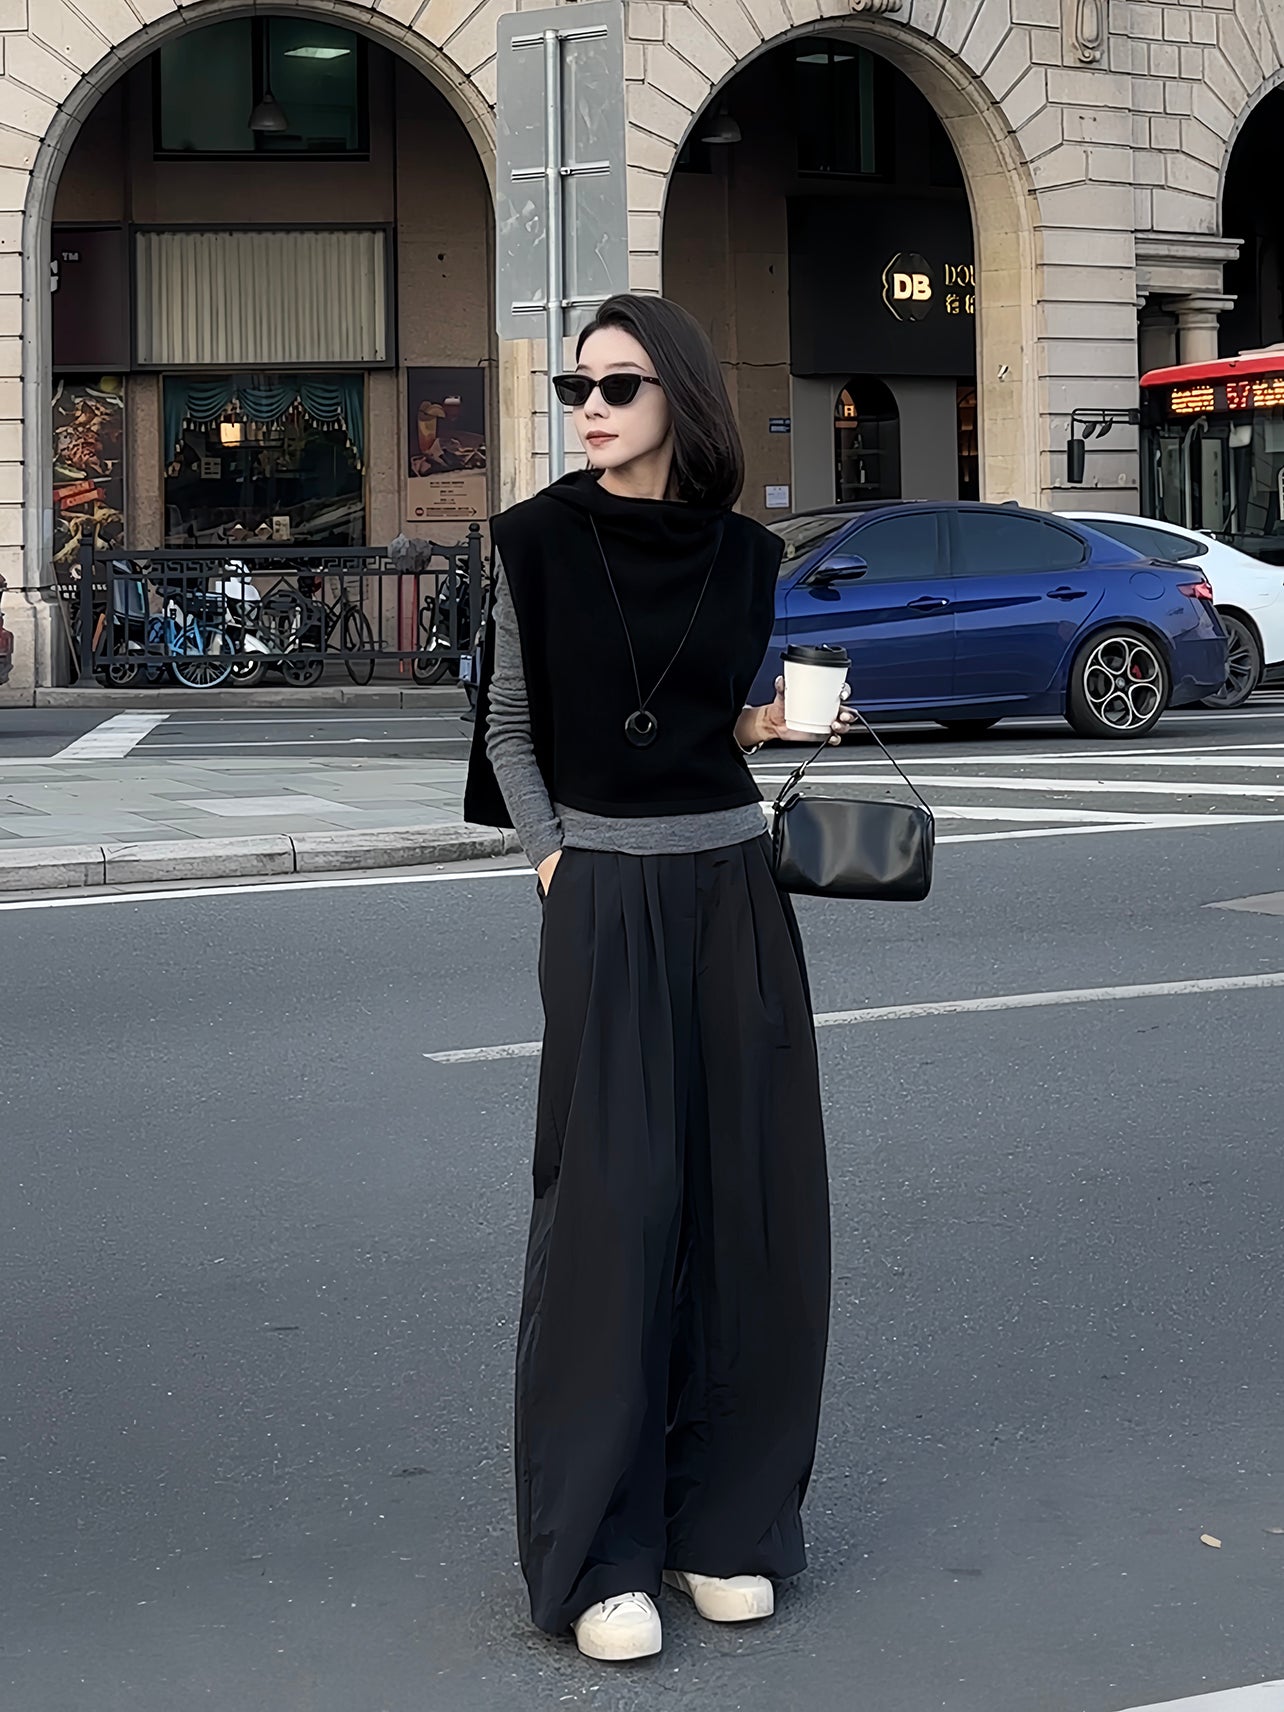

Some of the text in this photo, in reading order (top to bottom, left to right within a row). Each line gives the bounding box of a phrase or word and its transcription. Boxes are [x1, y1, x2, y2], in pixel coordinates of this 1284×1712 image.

[62, 252, 79, 261] TM
[893, 273, 932, 301] DB
[1226, 381, 1251, 409] 57
